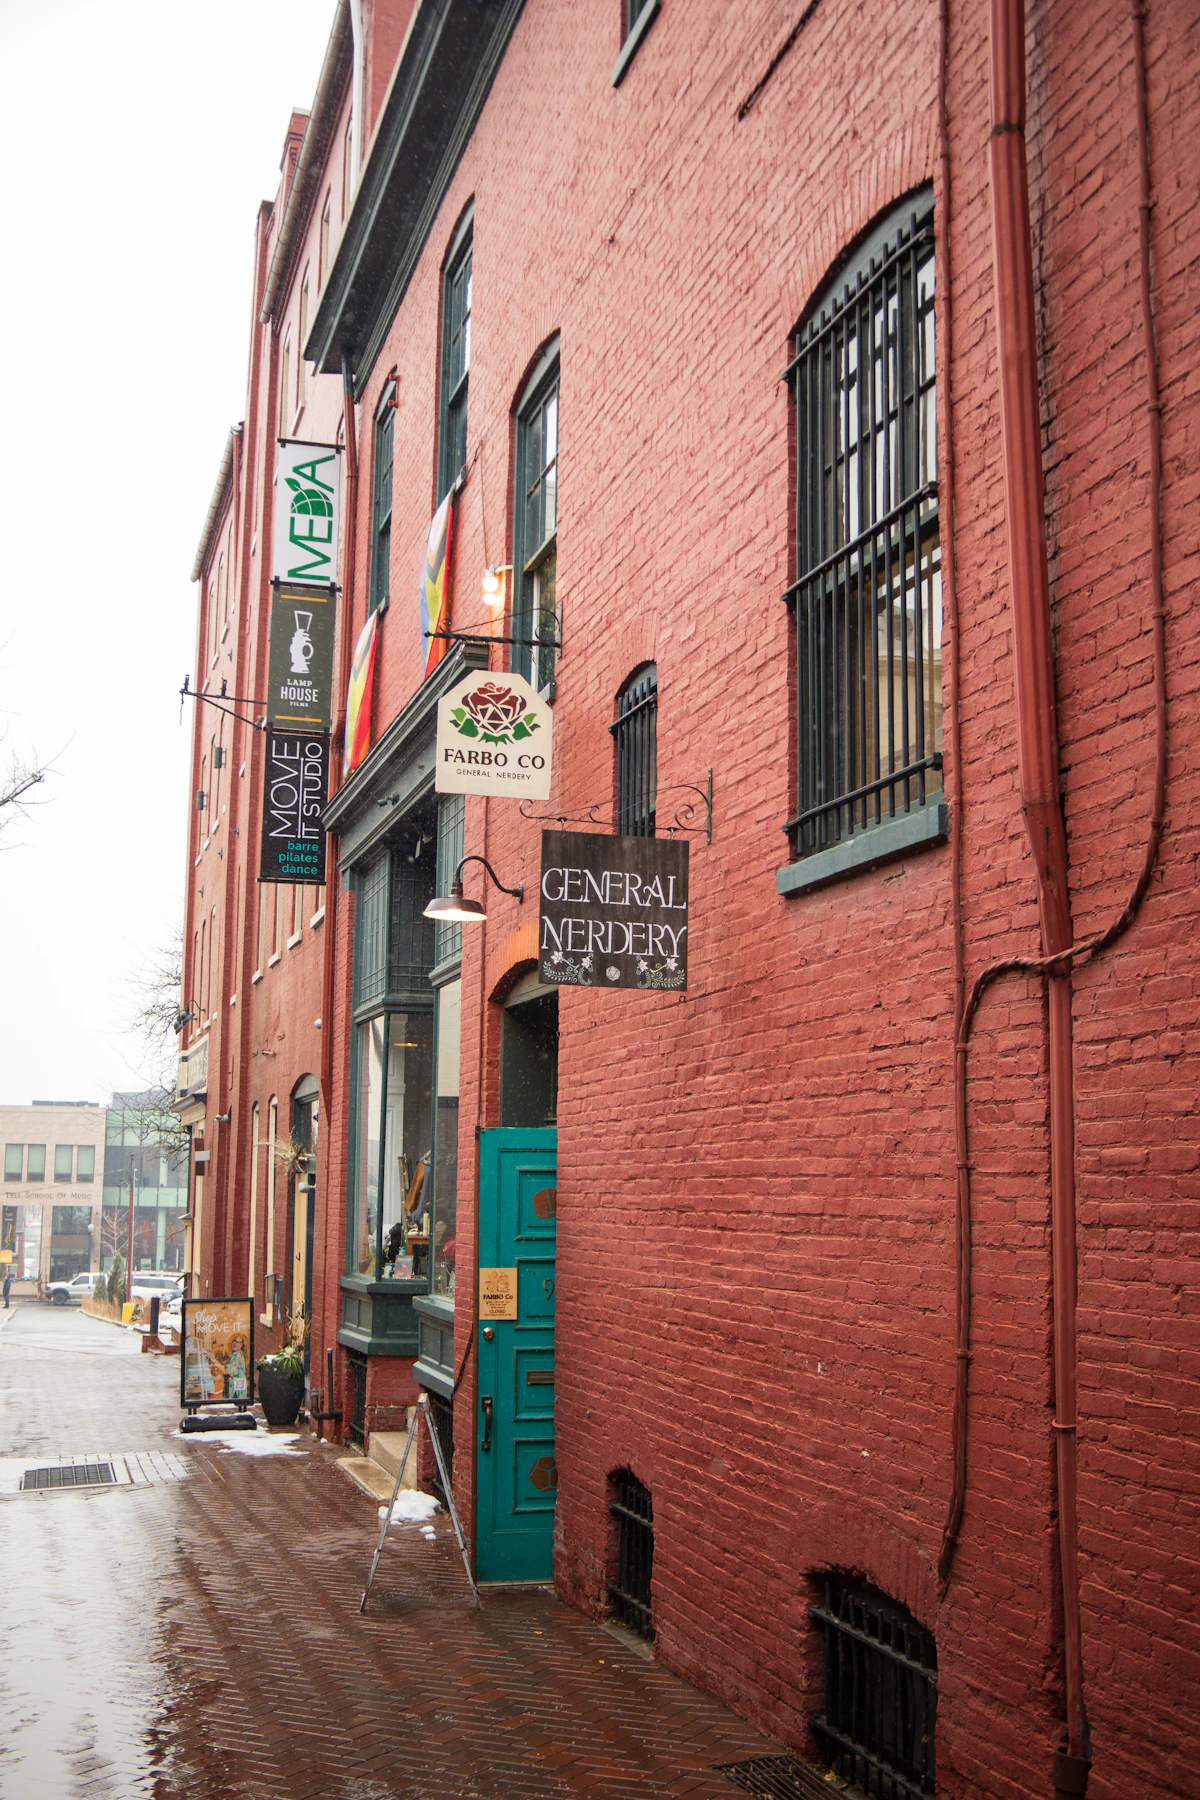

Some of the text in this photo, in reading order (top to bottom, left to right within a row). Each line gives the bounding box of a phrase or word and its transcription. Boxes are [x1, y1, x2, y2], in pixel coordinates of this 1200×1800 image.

[287, 678, 313, 687] LAMP
[280, 686, 319, 702] HOUSE
[443, 748, 546, 770] FARBO CO
[456, 769, 531, 781] GENERAL NERDERY
[268, 740, 300, 838] MOVE
[302, 742, 323, 839] IT STUDIO
[287, 841, 319, 852] barre
[278, 853, 319, 864] pilates
[281, 864, 318, 875] dance
[541, 867, 687, 910] GENERAL
[541, 915, 688, 958] NERDERY
[542, 1277, 555, 1301] 9
[193, 1308, 217, 1326] Shop
[197, 1322, 242, 1333] MOVE IT
